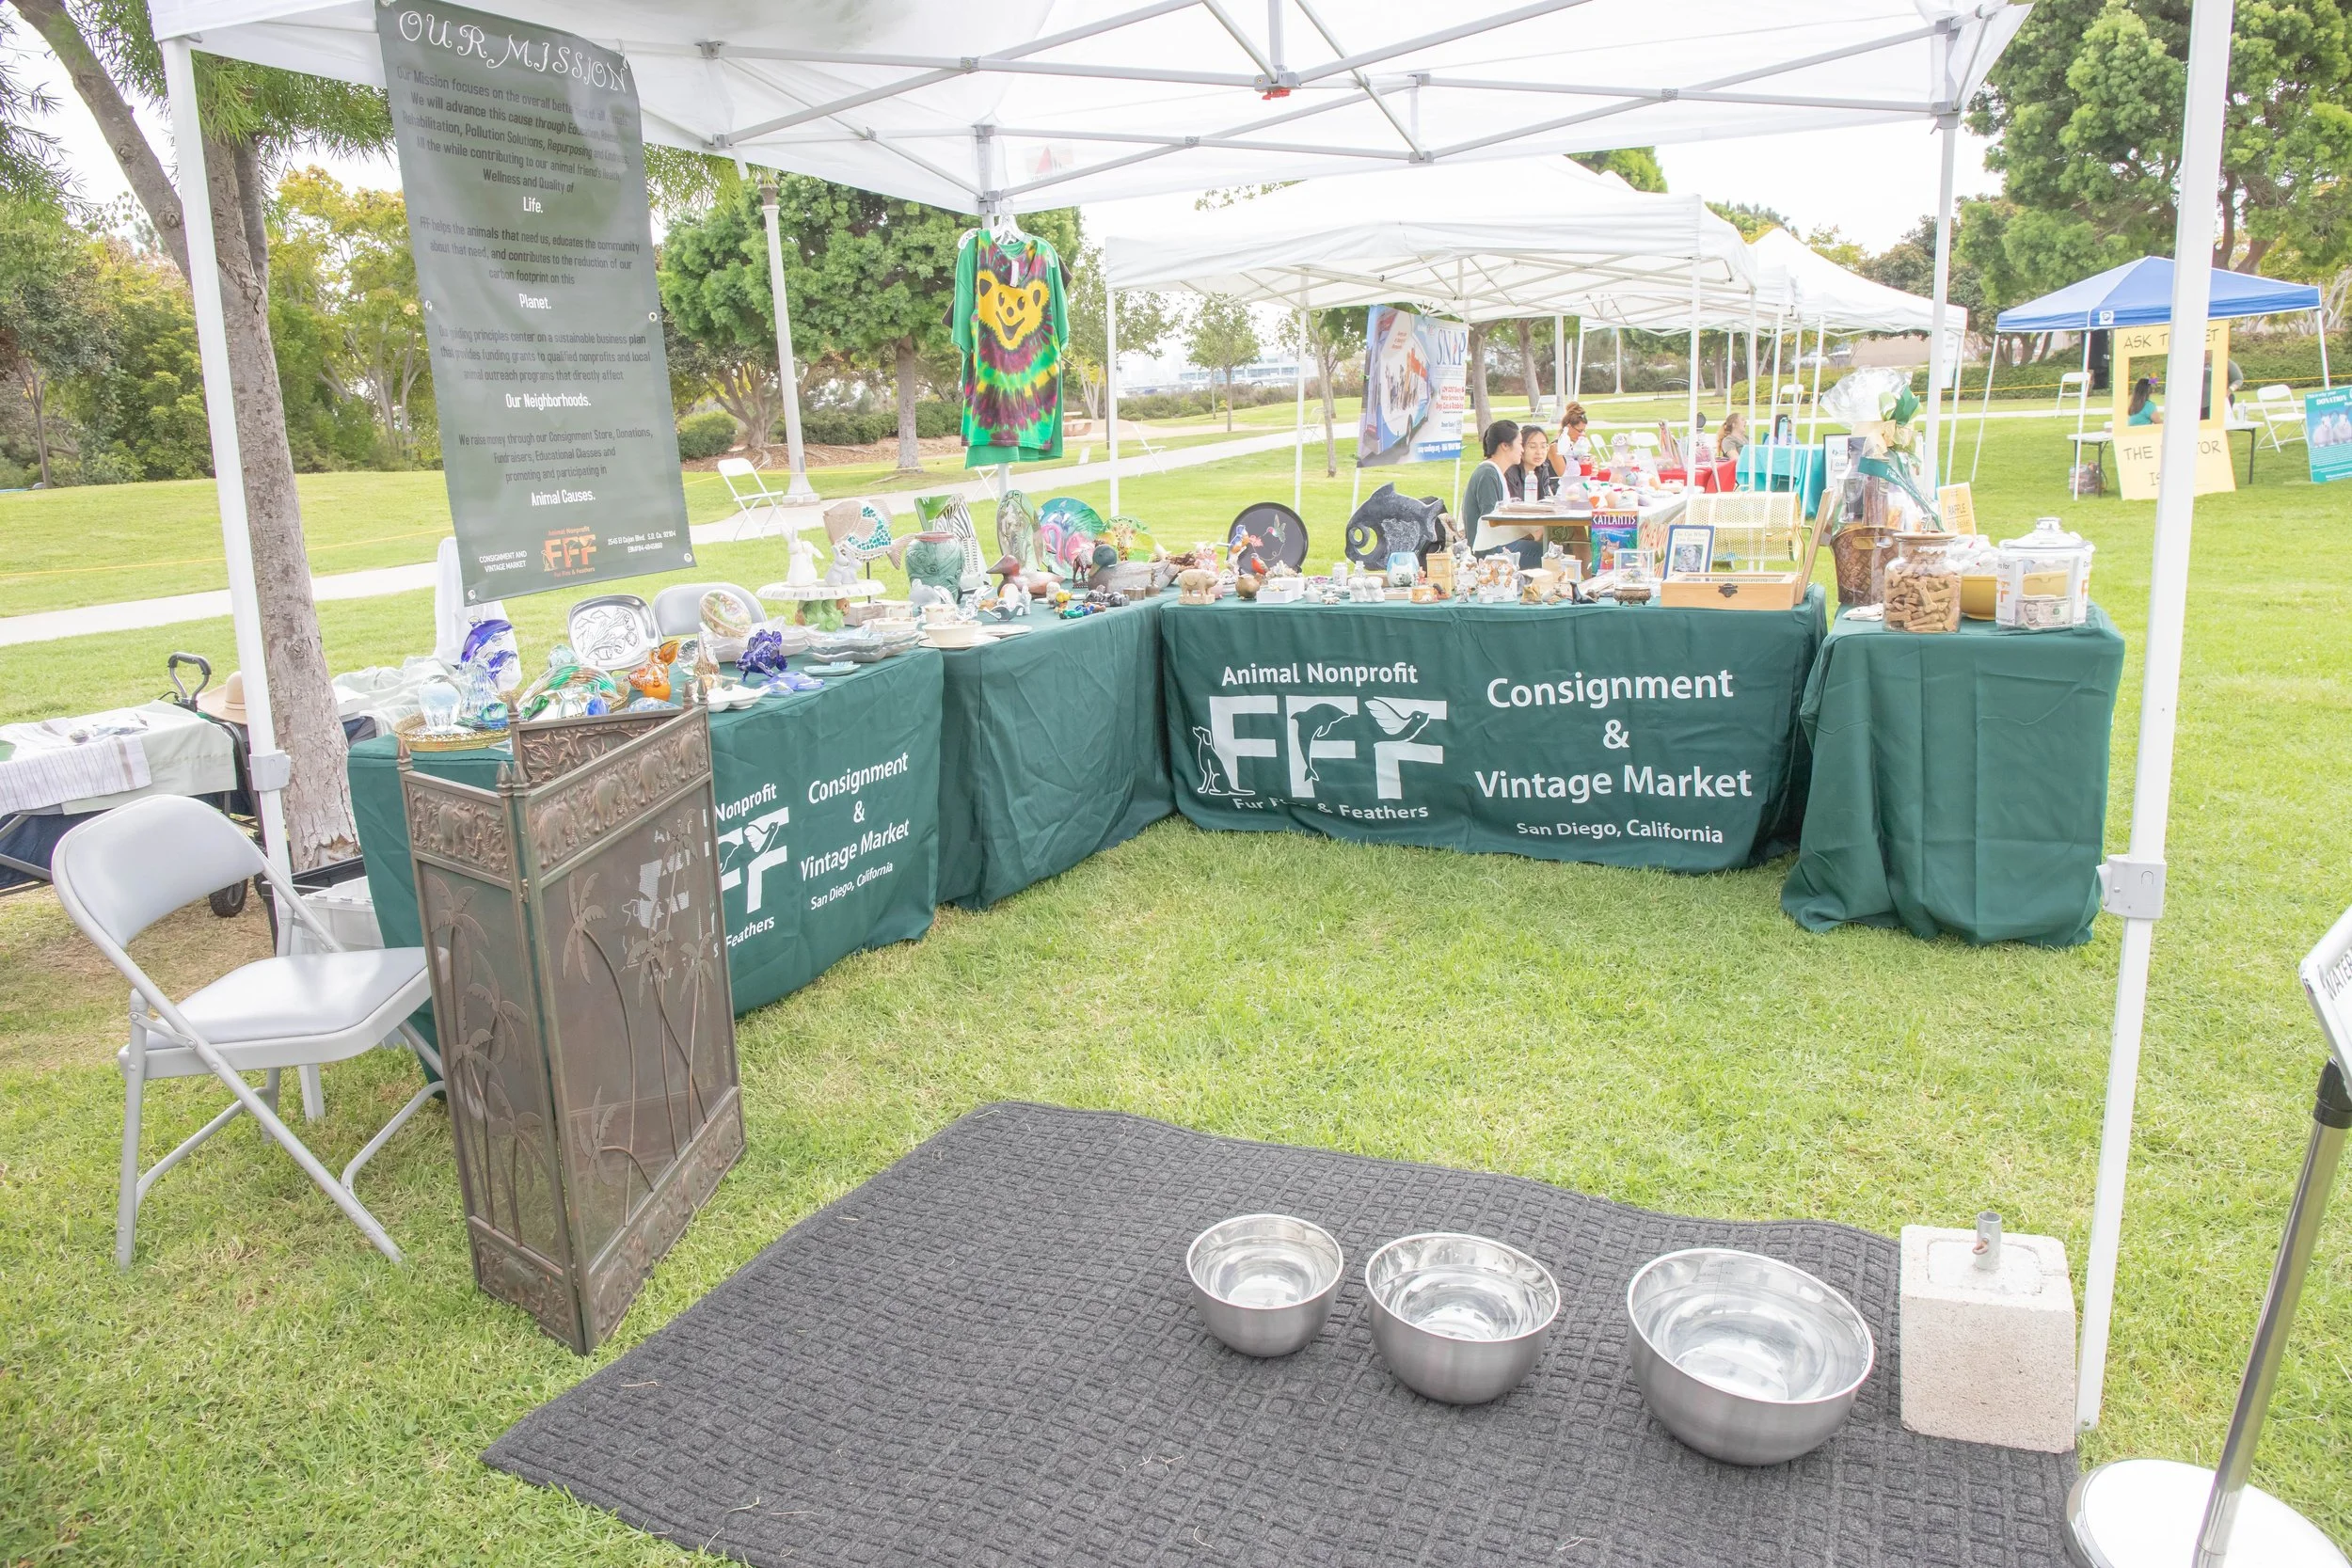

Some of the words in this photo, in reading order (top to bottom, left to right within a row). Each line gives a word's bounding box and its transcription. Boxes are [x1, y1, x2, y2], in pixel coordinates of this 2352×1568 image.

[399, 10, 487, 58] OUR
[486, 34, 629, 93] MISSION
[397, 66, 410, 80] Our
[414, 71, 449, 89] Mission
[453, 78, 489, 96] focuses
[493, 89, 502, 100] on
[506, 90, 520, 102] the
[522, 96, 550, 110] overall
[411, 91, 424, 105] We
[427, 97, 443, 109] will
[446, 102, 486, 117] advance
[489, 108, 506, 121] this
[509, 113, 532, 126] cause
[535, 117, 565, 135] through
[403, 110, 463, 137] Rehabilitation,
[466, 123, 505, 141] Pollution
[507, 131, 545, 151] Solutions,
[548, 139, 593, 159] Repurposing
[594, 150, 604, 159] and
[417, 136, 425, 149] All
[427, 139, 441, 151] the
[444, 144, 468, 156] while
[470, 148, 523, 167] contributing
[526, 156, 533, 166] to
[535, 158, 548, 168] our
[550, 161, 575, 174] animal
[578, 164, 601, 178] friend's
[484, 168, 520, 184] Wellness
[523, 177, 537, 187] and
[539, 177, 564, 194] Quality
[567, 182, 574, 193] of
[523, 197, 543, 213] Life.
[420, 216, 431, 229] FFF
[432, 219, 451, 234] helps
[453, 221, 465, 234] the
[467, 225, 499, 239] animals
[501, 229, 519, 241] that
[521, 232, 538, 244] need
[540, 235, 550, 246] us,
[553, 235, 583, 248] educates
[585, 239, 596, 248] the
[598, 240, 640, 255] community
[430, 239, 450, 253] about
[452, 243, 467, 255] that
[469, 246, 489, 260] need,
[491, 248, 505, 260] and
[509, 251, 550, 264] contributes
[553, 255, 560, 264] to
[562, 255, 572, 265] the
[574, 257, 609, 268] reduction
[611, 259, 617, 269] of
[620, 261, 632, 270] our
[489, 268, 514, 280] carbon
[516, 272, 548, 284] footprint
[551, 274, 560, 284] on
[562, 274, 575, 284] this
[519, 293, 551, 309] Planet.
[474, 329, 509, 343] principles
[511, 333, 535, 342] center
[555, 333, 595, 343] sustainable
[596, 334, 627, 344] business
[628, 335, 645, 346] plan
[2124, 334, 2152, 349] ASK
[441, 346, 454, 358] that
[483, 349, 511, 363] funding
[512, 352, 535, 363] grants
[547, 352, 578, 363] qualified
[580, 352, 615, 365] nonprofits
[617, 352, 630, 361] and
[632, 352, 650, 361] local
[485, 370, 517, 381] outreach
[520, 371, 554, 383] programs
[556, 371, 571, 381] that
[573, 371, 600, 383] directly
[602, 370, 624, 380] affect
[505, 393, 521, 408] Our
[524, 393, 591, 410] Neighborhoods.
[459, 434, 470, 446] We
[470, 433, 486, 446] raise
[486, 434, 506, 448] money
[507, 432, 534, 445] through
[536, 433, 548, 443] our
[548, 431, 593, 444] Consignment
[595, 430, 615, 441] Store,
[616, 428, 653, 439] Donations,
[494, 451, 534, 464] Fundraisers,
[535, 449, 575, 461] Educational
[576, 448, 602, 459] Classes
[603, 446, 616, 457] and
[2123, 446, 2153, 461] THE
[505, 468, 541, 483] promoting
[542, 468, 555, 479] and
[556, 465, 600, 481] participating
[601, 465, 607, 475] in
[532, 489, 560, 506] Animal
[561, 488, 596, 504] Causes.
[1593, 515, 1636, 525] CATLANTIS
[545, 534, 596, 568] FFF
[623, 535, 634, 544] Cajon
[479, 552, 515, 562] CONSIGNMENT
[485, 563, 505, 572] VINTAGE
[506, 561, 526, 569] MARKET
[1221, 663, 1302, 687] Animal
[1307, 662, 1418, 685] Nonprofit
[1486, 669, 1734, 708] Consignment
[1602, 719, 1630, 749] &
[1209, 695, 1448, 800] FFF
[808, 752, 909, 804] Consignment
[1473, 766, 1613, 803] Vintage
[1624, 765, 1753, 798] Market
[715, 783, 777, 822] Nonprofit
[853, 800, 866, 823] &
[1232, 798, 1263, 810] Fur
[1317, 803, 1333, 814] &
[1339, 804, 1428, 819] Feathers
[1516, 822, 1552, 836] San
[1556, 820, 1622, 839] Diego,
[1626, 819, 1724, 844] California
[801, 842, 857, 881] Vintage
[860, 817, 909, 856] Market
[810, 895, 828, 911] San
[829, 881, 855, 902] Diego,
[856, 862, 893, 888] California
[725, 916, 775, 948] Feathers
